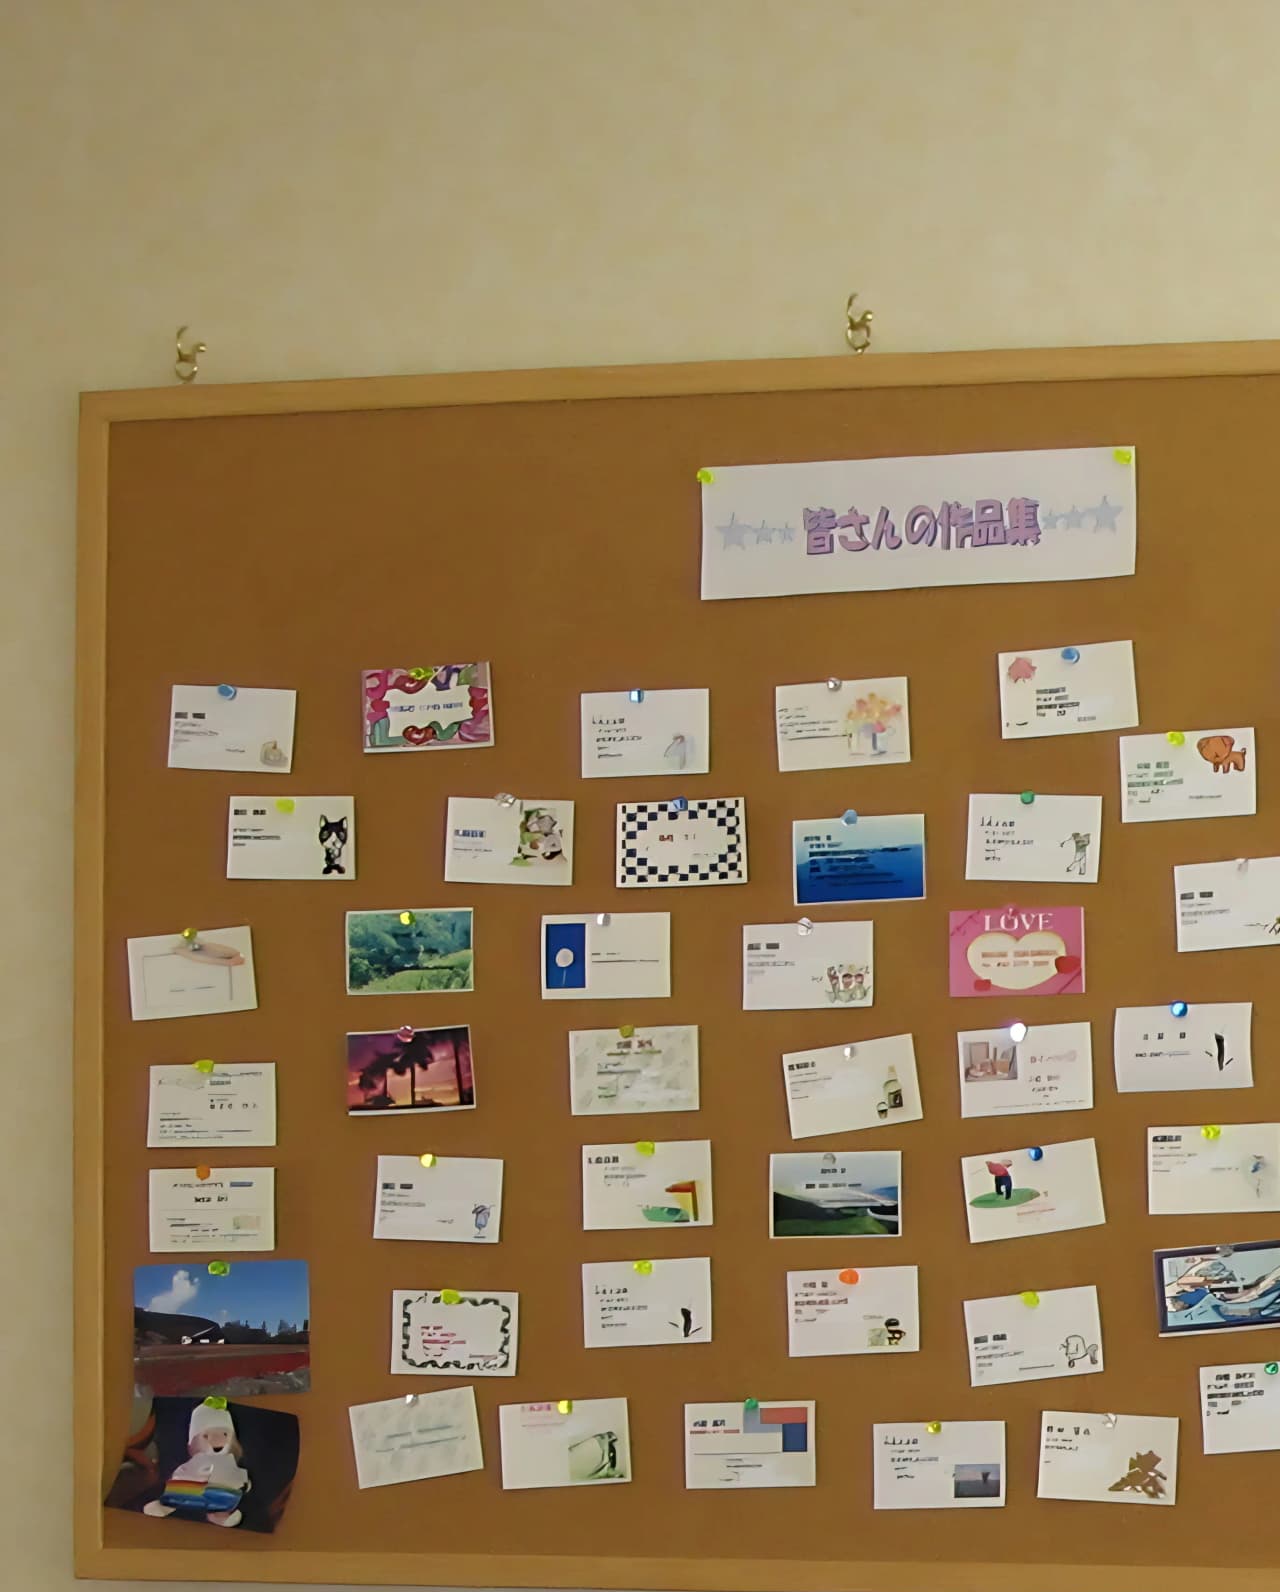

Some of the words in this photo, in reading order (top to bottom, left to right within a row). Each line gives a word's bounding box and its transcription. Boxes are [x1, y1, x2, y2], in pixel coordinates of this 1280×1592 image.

[803, 497, 1042, 555] 皆さんの作品集
[984, 910, 1054, 932] LOVE
